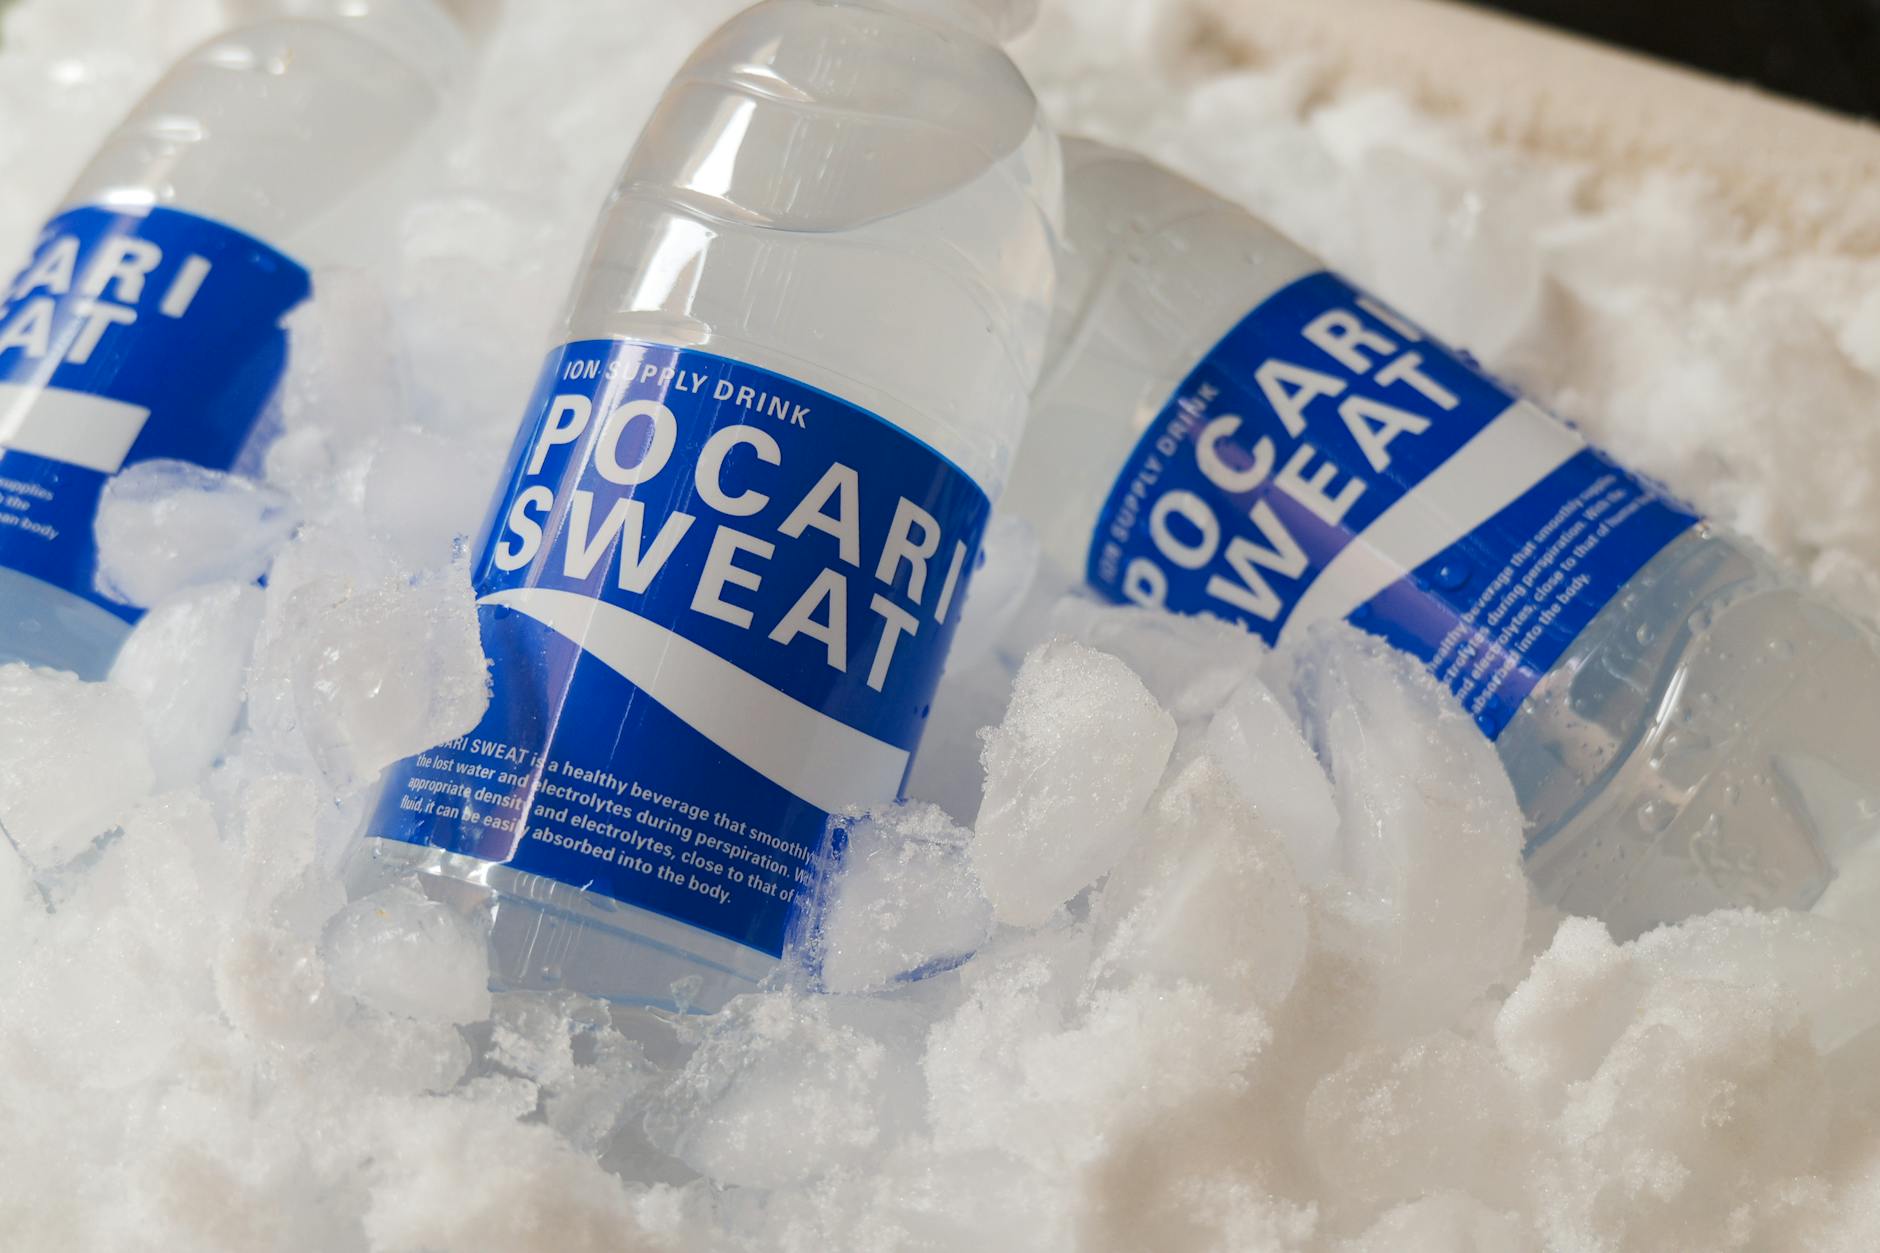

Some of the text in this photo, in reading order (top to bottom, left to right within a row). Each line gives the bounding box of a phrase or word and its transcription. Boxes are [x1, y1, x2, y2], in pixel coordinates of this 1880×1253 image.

[8, 234, 213, 319] ARI
[0, 297, 138, 365] AT
[563, 359, 812, 429] ION SUPPLY DRINK
[526, 393, 967, 625] POCARI
[1110, 454, 1163, 543] SUPPLY
[1157, 381, 1219, 457] DRINK
[1205, 350, 1461, 623] WEAT
[494, 484, 920, 693] SWEAT
[1461, 566, 1514, 624] beverage
[1510, 540, 1537, 567] that
[1487, 584, 1528, 626] during
[1534, 570, 1565, 602] close
[1560, 556, 1577, 572] to
[1573, 533, 1600, 559] that
[1514, 622, 1543, 653] into
[1538, 602, 1563, 627] the
[416, 753, 432, 768] the
[432, 754, 455, 772] lost
[456, 762, 496, 780] water
[497, 770, 530, 788] and
[636, 809, 693, 842] during
[694, 831, 791, 878] perspiration.
[470, 738, 530, 764] SWEAT
[530, 752, 544, 768] is
[547, 760, 559, 773] a
[562, 760, 628, 795] healthy
[630, 781, 710, 822] beverage
[713, 811, 747, 836] that
[400, 794, 423, 813] fluid,
[424, 799, 435, 814] it
[436, 804, 460, 820] can
[461, 805, 480, 823] be
[532, 826, 616, 862] absorbed
[617, 851, 653, 875] into
[657, 864, 686, 886] the
[688, 875, 731, 904] body.
[407, 776, 795, 903] appropriate densit and electrolytes, close to that of
